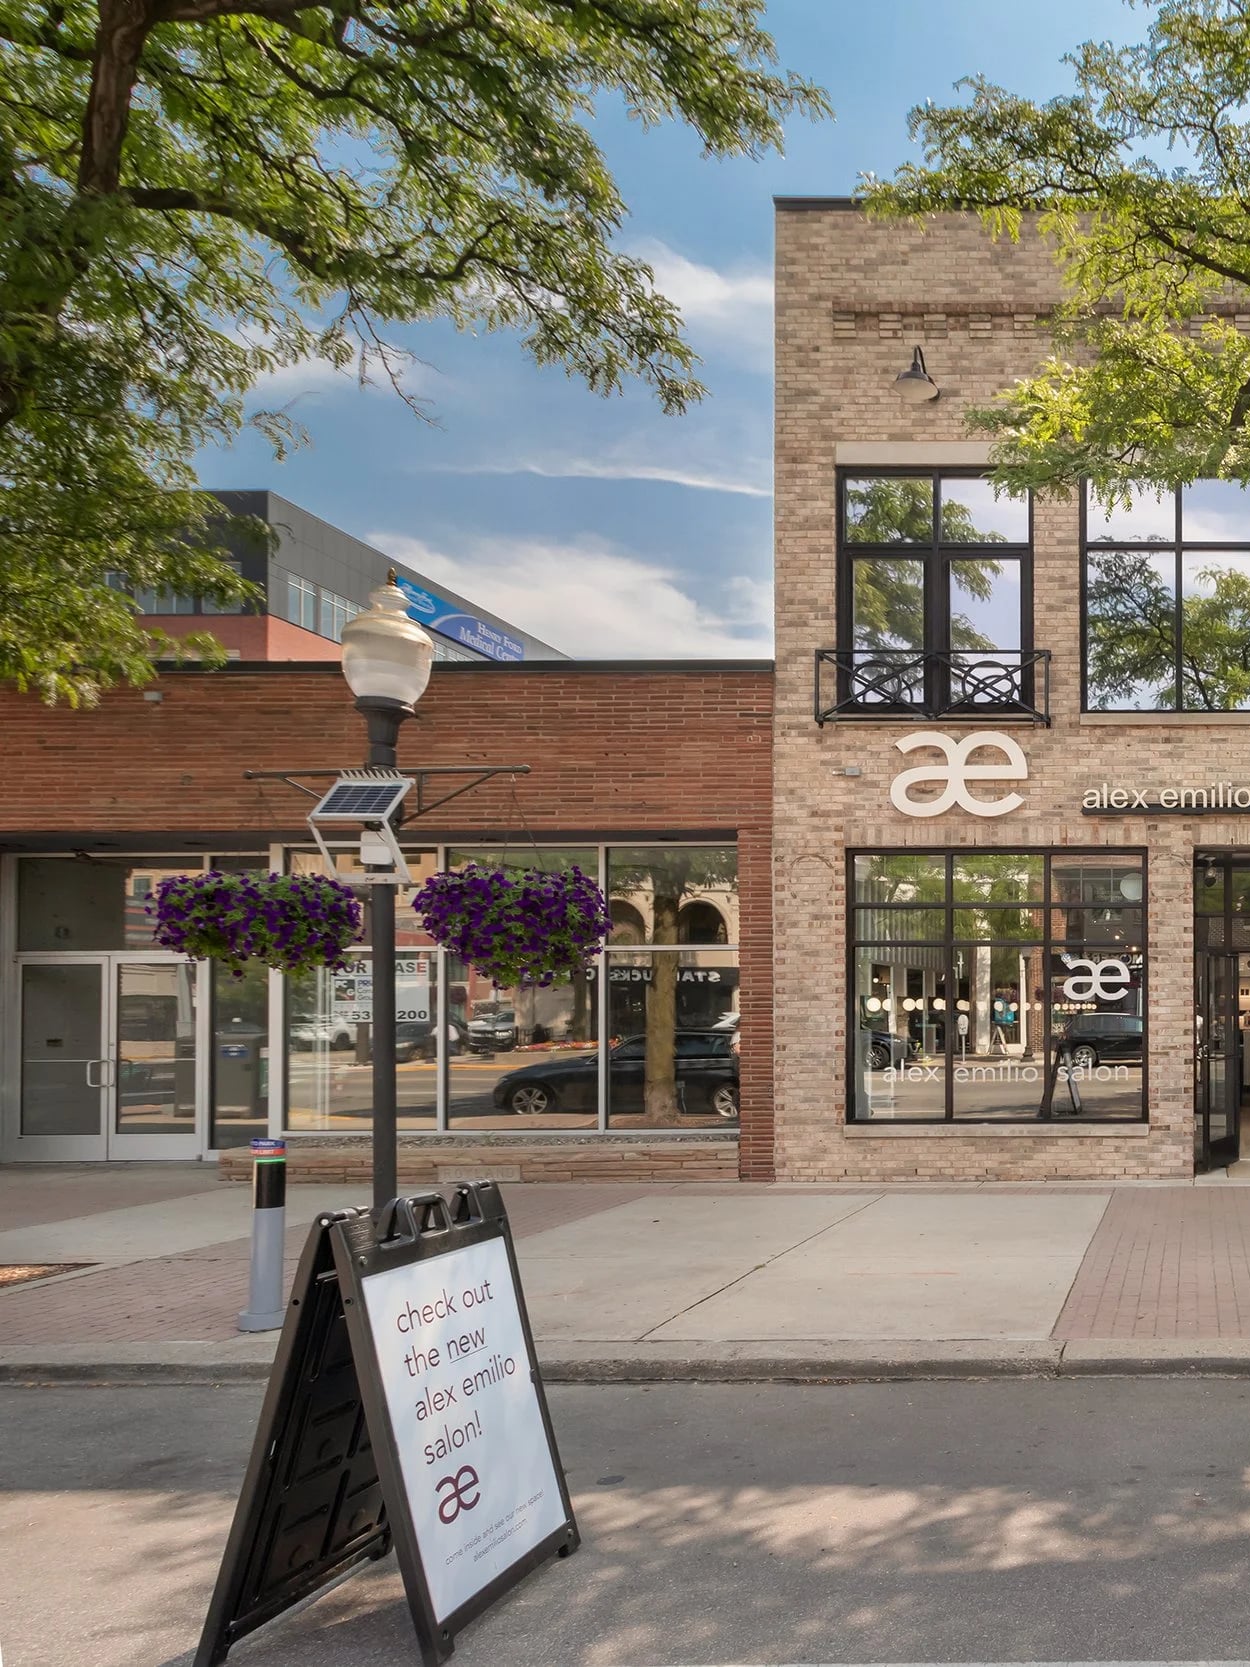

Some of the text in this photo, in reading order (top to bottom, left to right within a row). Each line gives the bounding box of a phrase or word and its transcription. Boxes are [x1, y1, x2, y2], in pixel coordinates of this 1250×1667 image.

[1082, 783, 1149, 809] alex
[331, 962, 427, 974] OR ASE
[883, 1058, 1129, 1083] alex emilio salon
[397, 1280, 493, 1333] check out
[404, 1327, 485, 1377] the new
[415, 1354, 516, 1421] alex emilio
[424, 1410, 482, 1465] salon!
